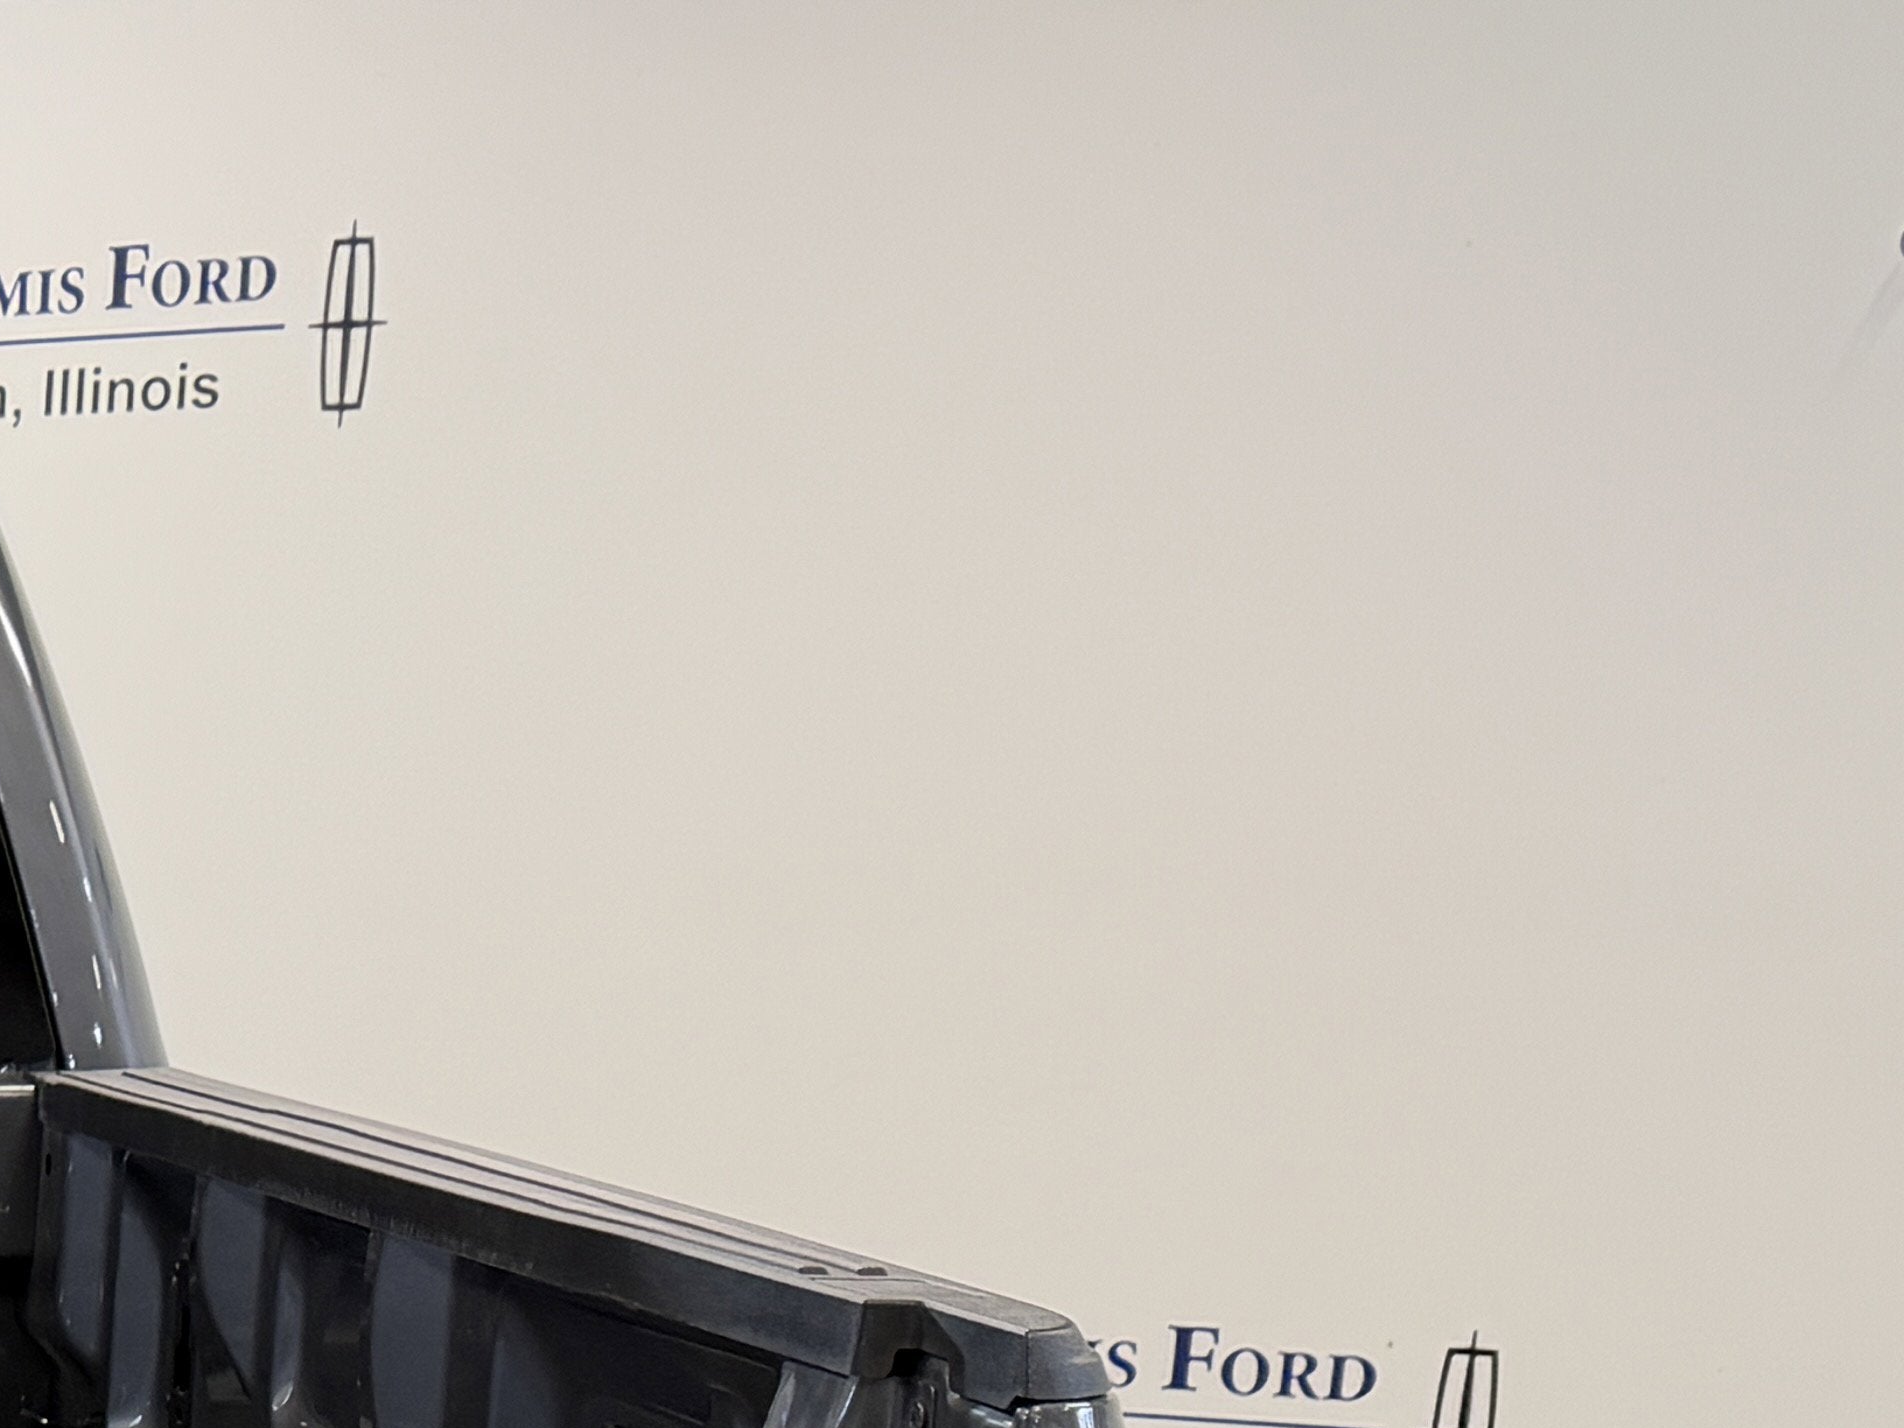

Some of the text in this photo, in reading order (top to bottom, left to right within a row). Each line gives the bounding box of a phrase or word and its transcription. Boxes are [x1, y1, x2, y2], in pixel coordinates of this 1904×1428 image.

[105, 242, 278, 311] FORD
[43, 361, 221, 417] Illinois
[1161, 1323, 1378, 1402] FORD
